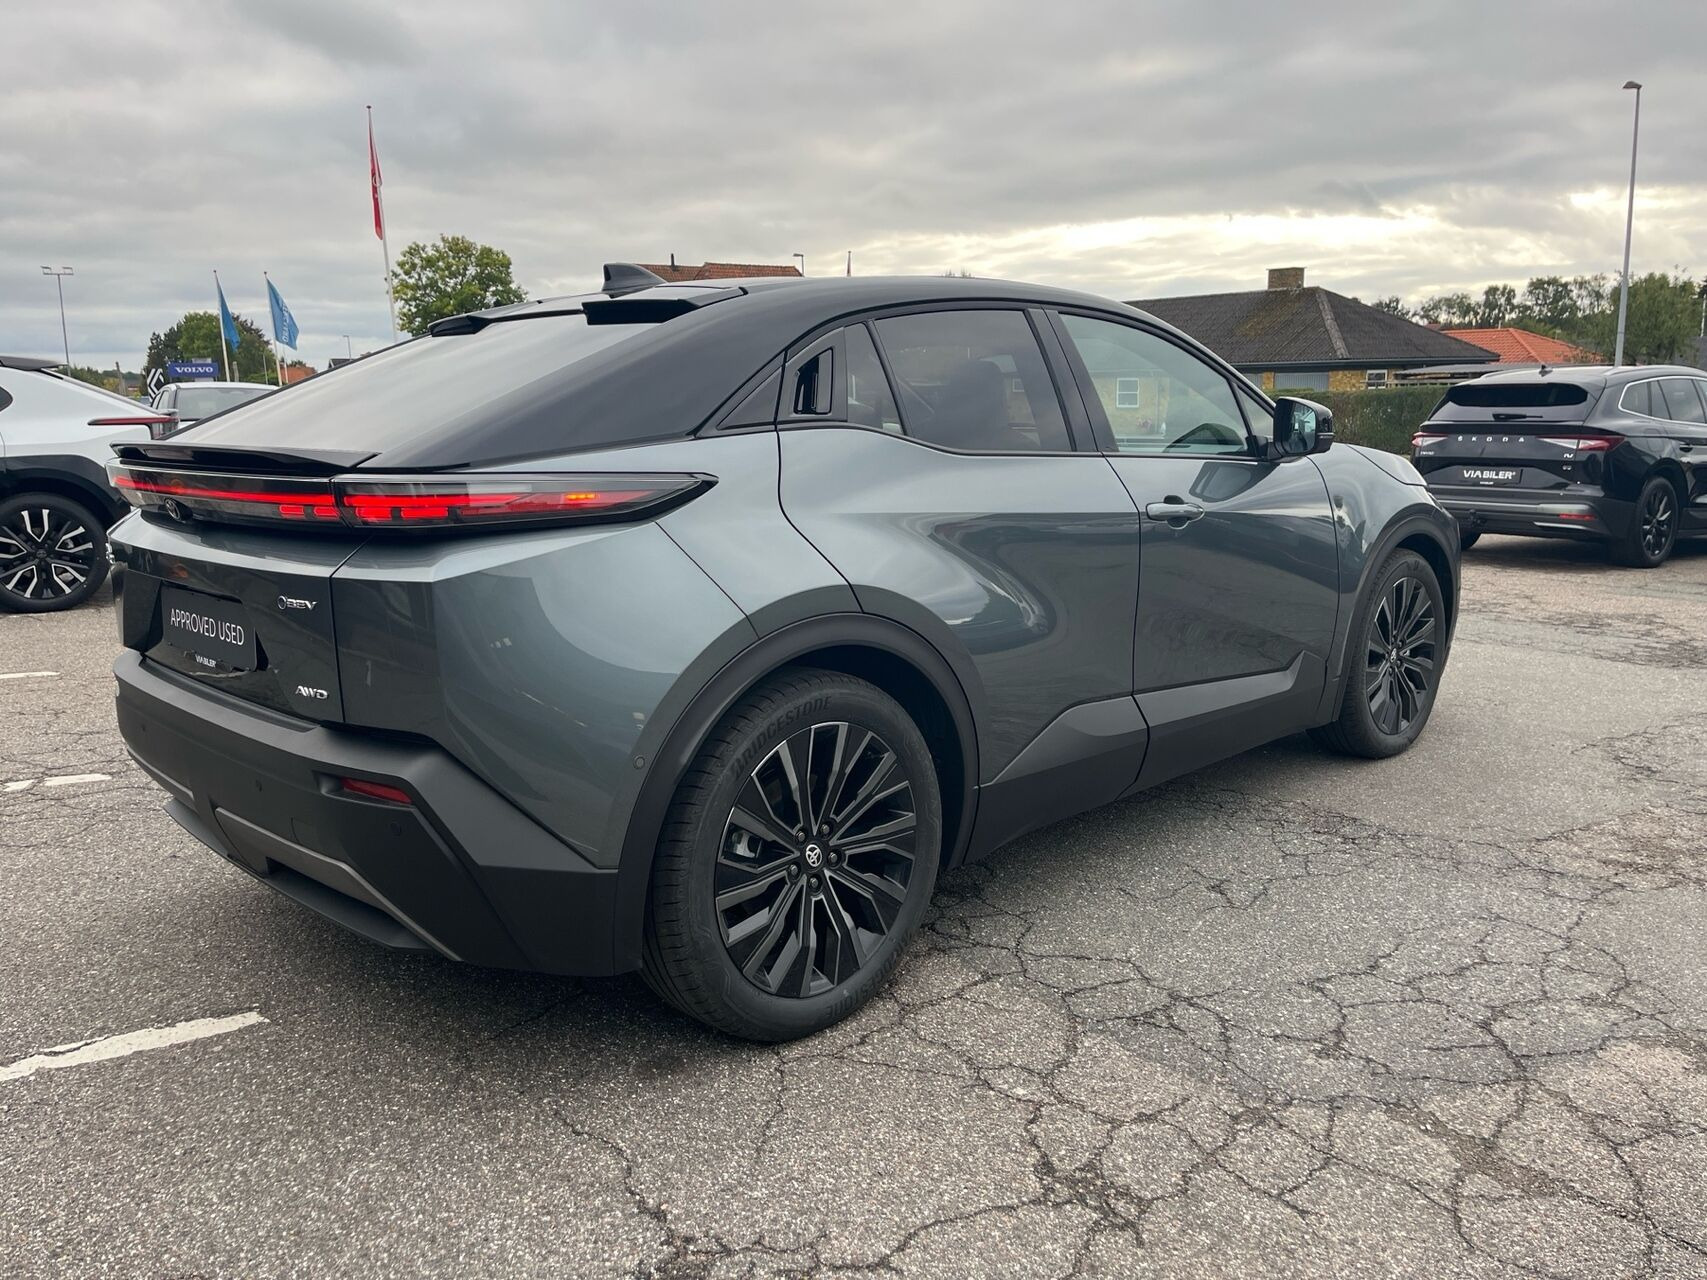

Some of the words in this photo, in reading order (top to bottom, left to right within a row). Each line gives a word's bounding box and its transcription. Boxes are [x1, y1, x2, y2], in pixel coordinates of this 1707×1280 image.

[175, 366, 214, 374] VOLVO
[170, 608, 216, 638] APPROVED
[218, 620, 245, 646] USED
[295, 685, 328, 700] AWD
[730, 695, 832, 781] BRIDGESTONE
